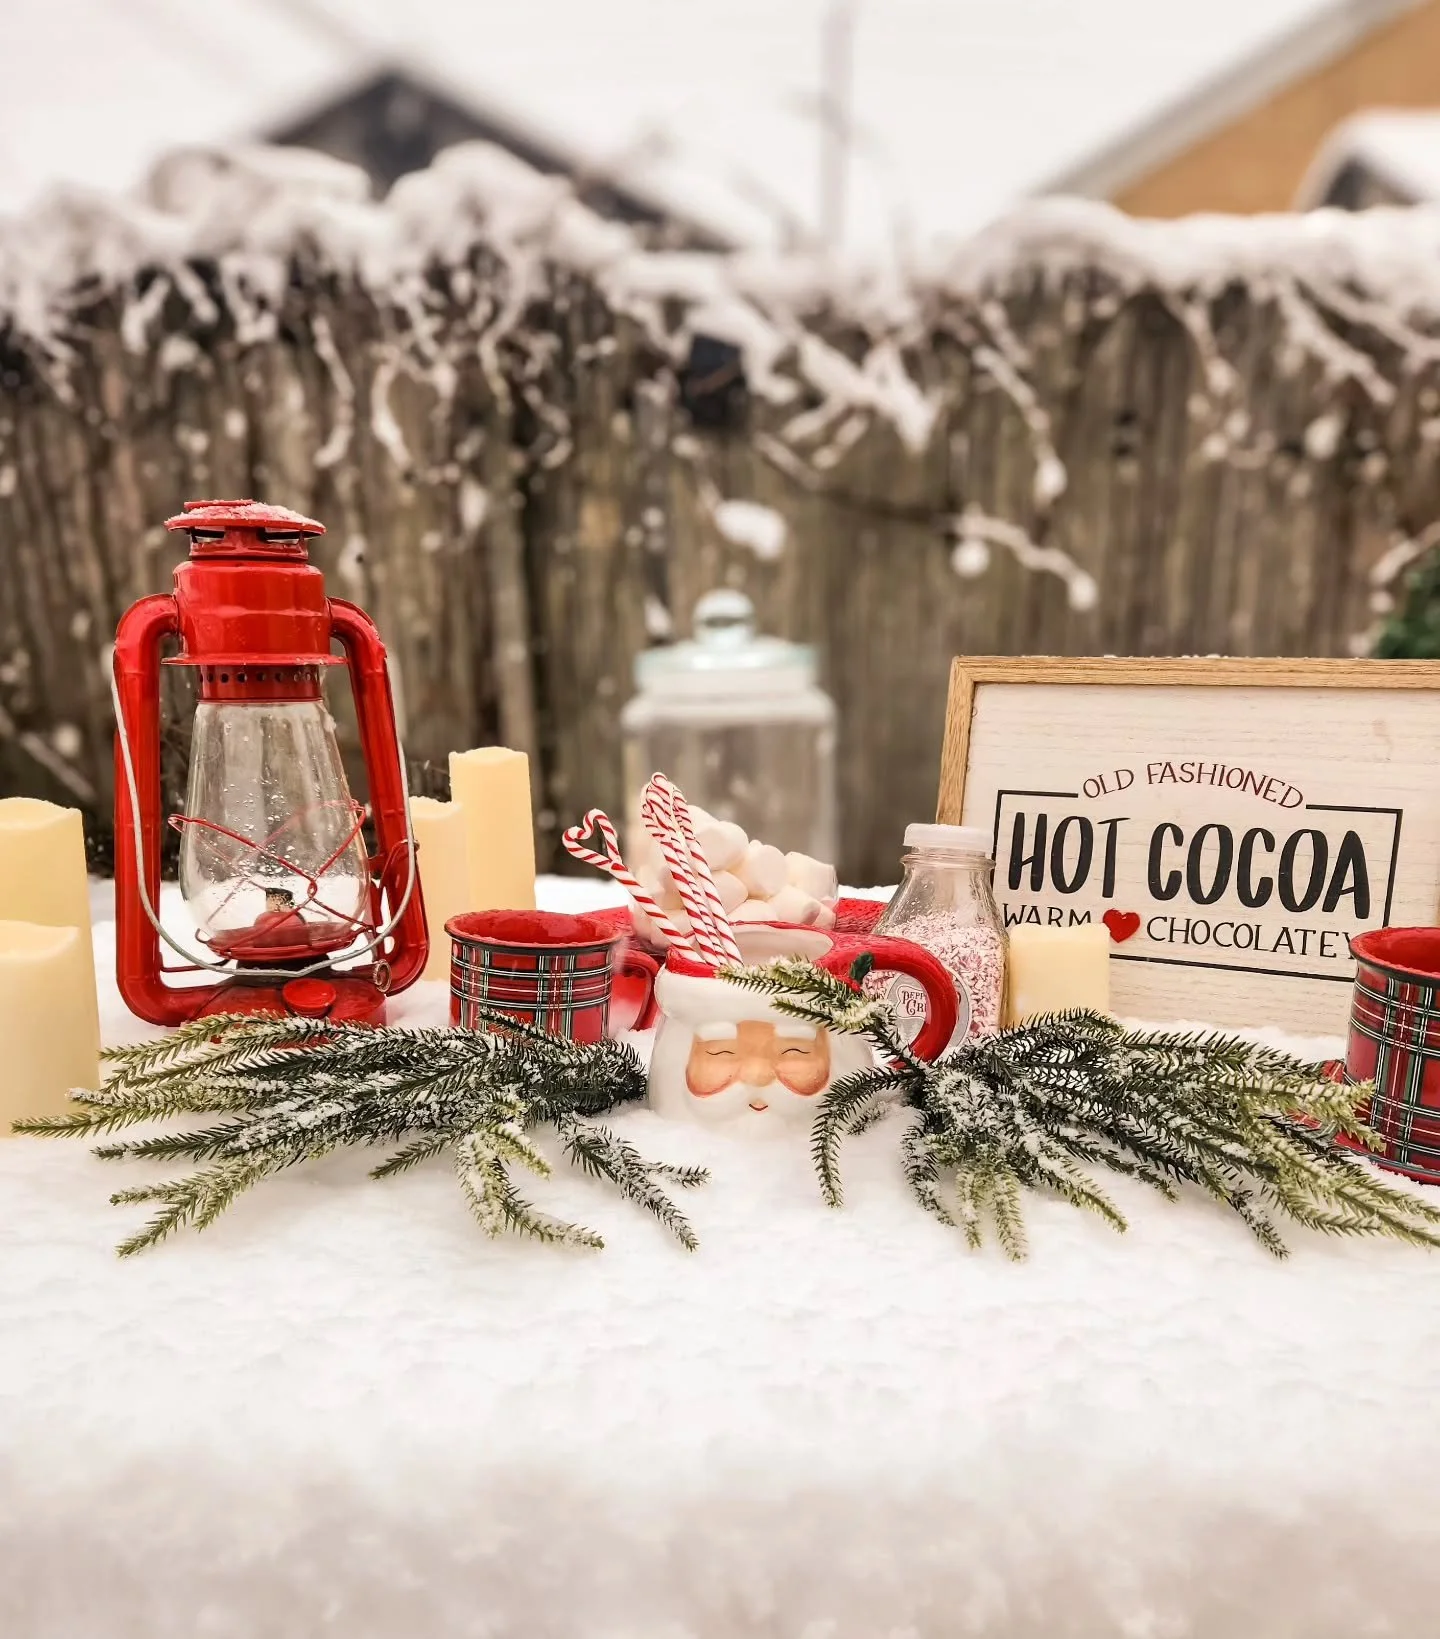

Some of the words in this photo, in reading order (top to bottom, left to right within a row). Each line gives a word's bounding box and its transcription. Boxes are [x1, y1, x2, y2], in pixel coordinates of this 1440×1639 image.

[1082, 768, 1135, 799] OLD
[1146, 761, 1304, 809] FASHIONED
[1007, 811, 1131, 898] HOT
[1147, 822, 1371, 919] COCOA
[1002, 902, 1092, 928] WARM
